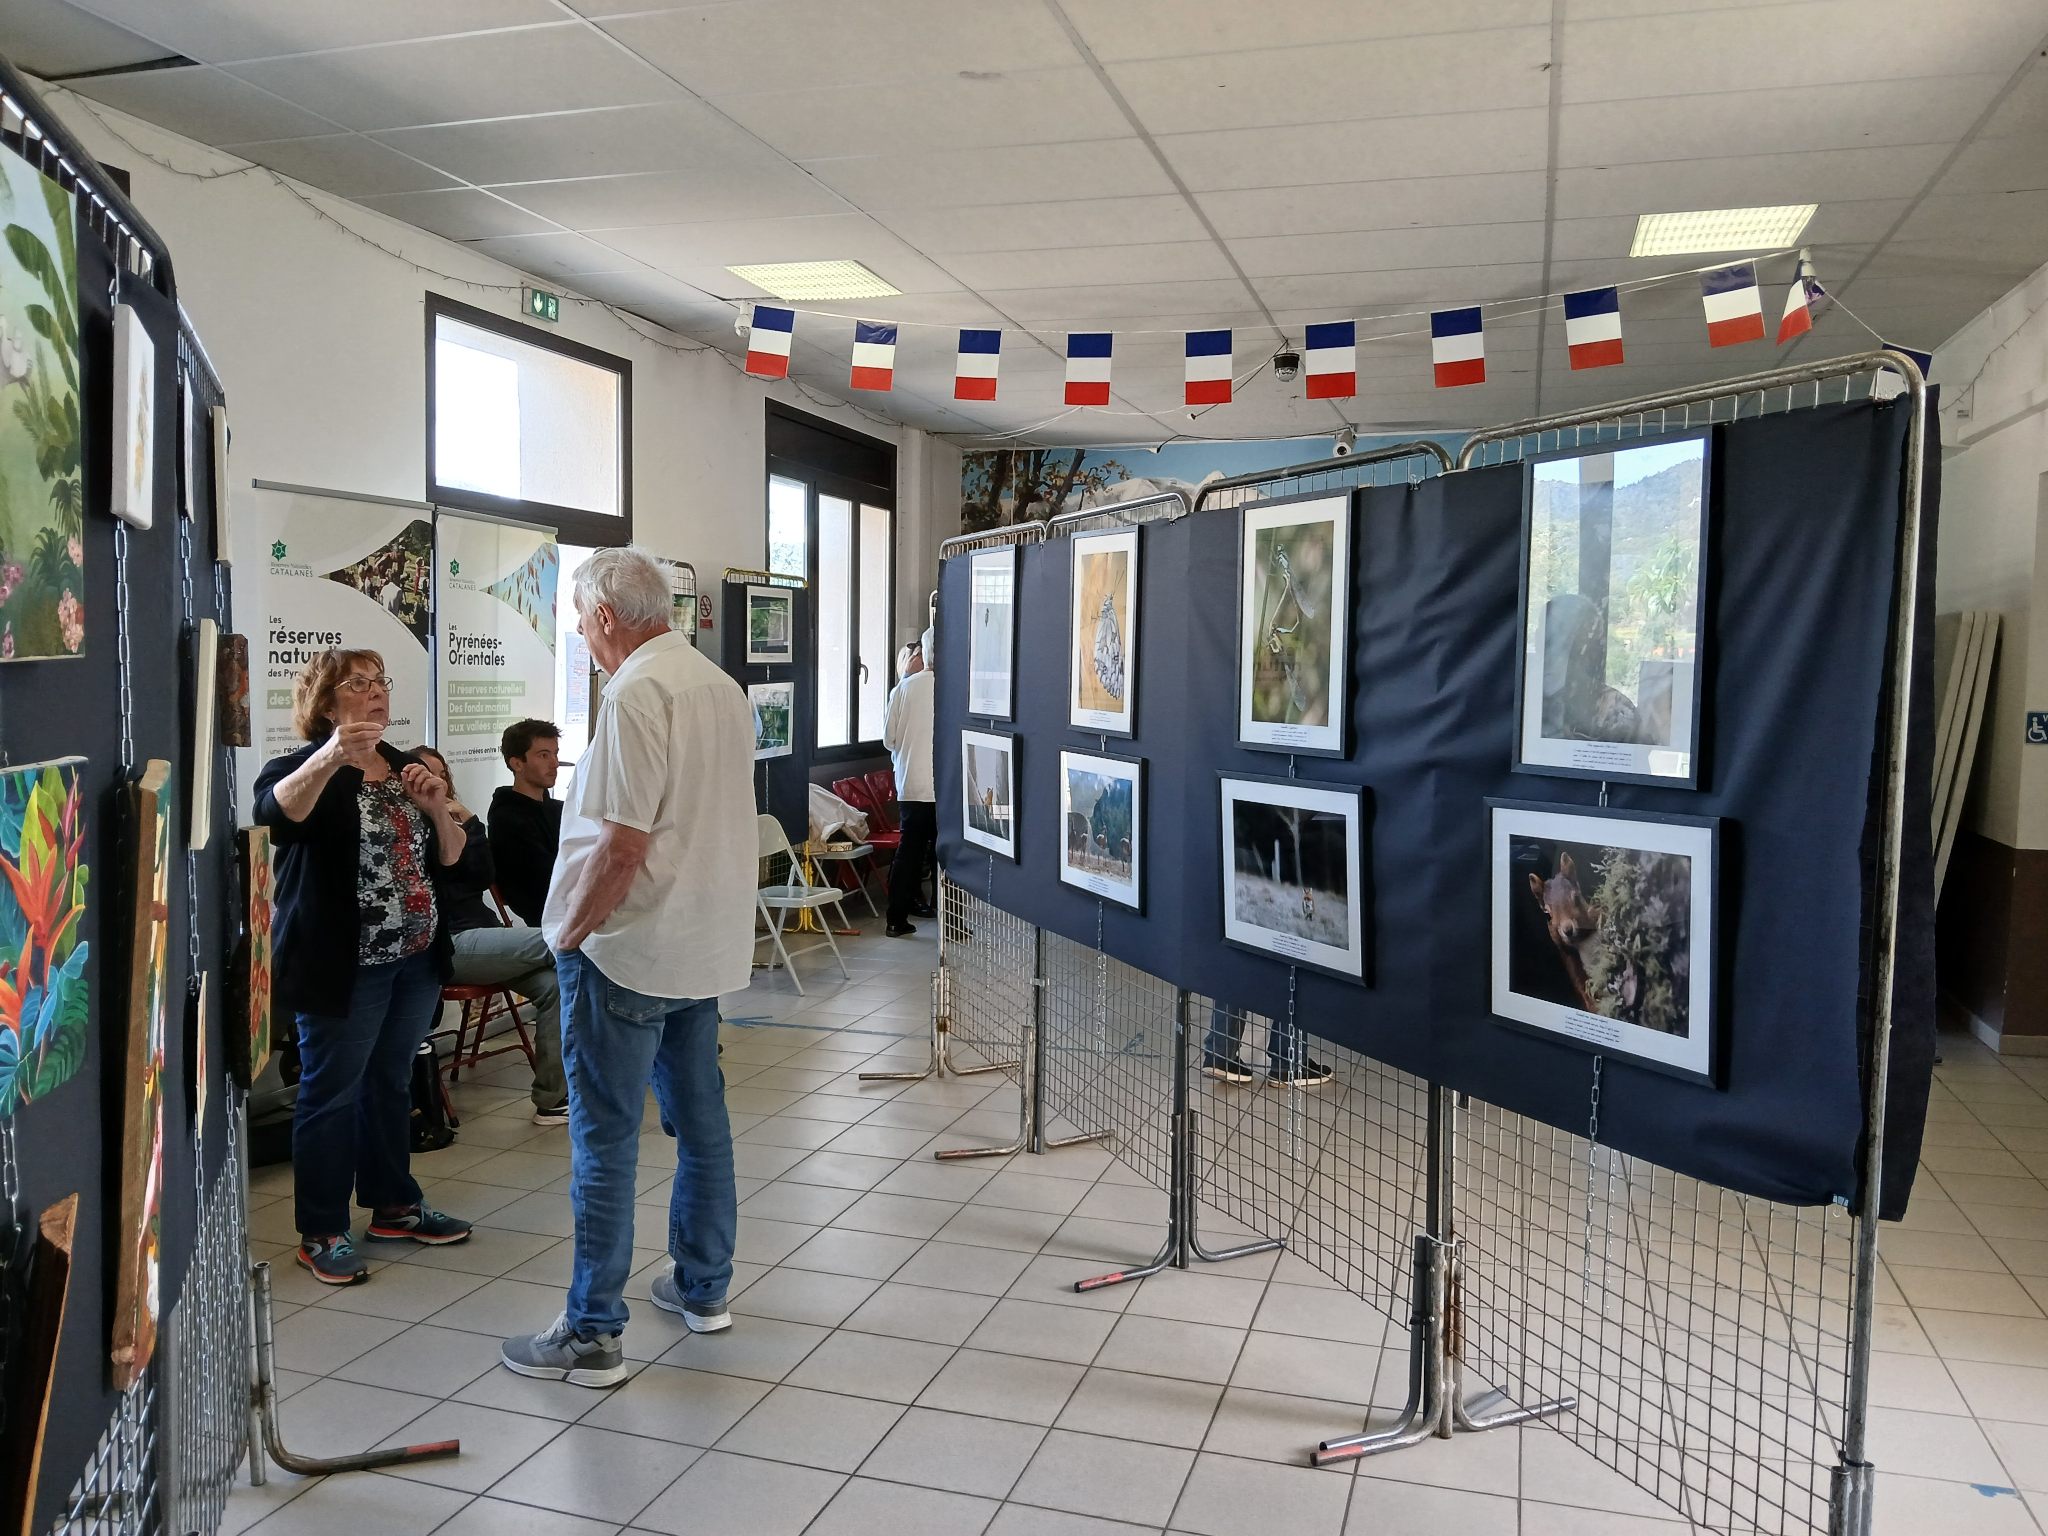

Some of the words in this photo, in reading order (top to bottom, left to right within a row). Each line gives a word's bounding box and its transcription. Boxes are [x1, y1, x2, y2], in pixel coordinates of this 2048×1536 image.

[270, 568, 313, 578] CATALANES
[448, 582, 477, 591] CATALANES
[269, 615, 282, 624] Les
[448, 622, 458, 631] Les
[269, 625, 342, 645] réserves
[448, 632, 502, 653] Pyrénées-
[268, 647, 320, 665] natu
[448, 649, 505, 666] Orientales
[267, 669, 282, 678] des
[283, 669, 299, 680] Pyr
[457, 683, 487, 694] réserves
[269, 693, 291, 706] des
[449, 702, 463, 713] Des
[464, 702, 483, 713] fonds
[485, 703, 510, 712] marins
[448, 724, 464, 732] aux
[466, 720, 491, 731] vallées
